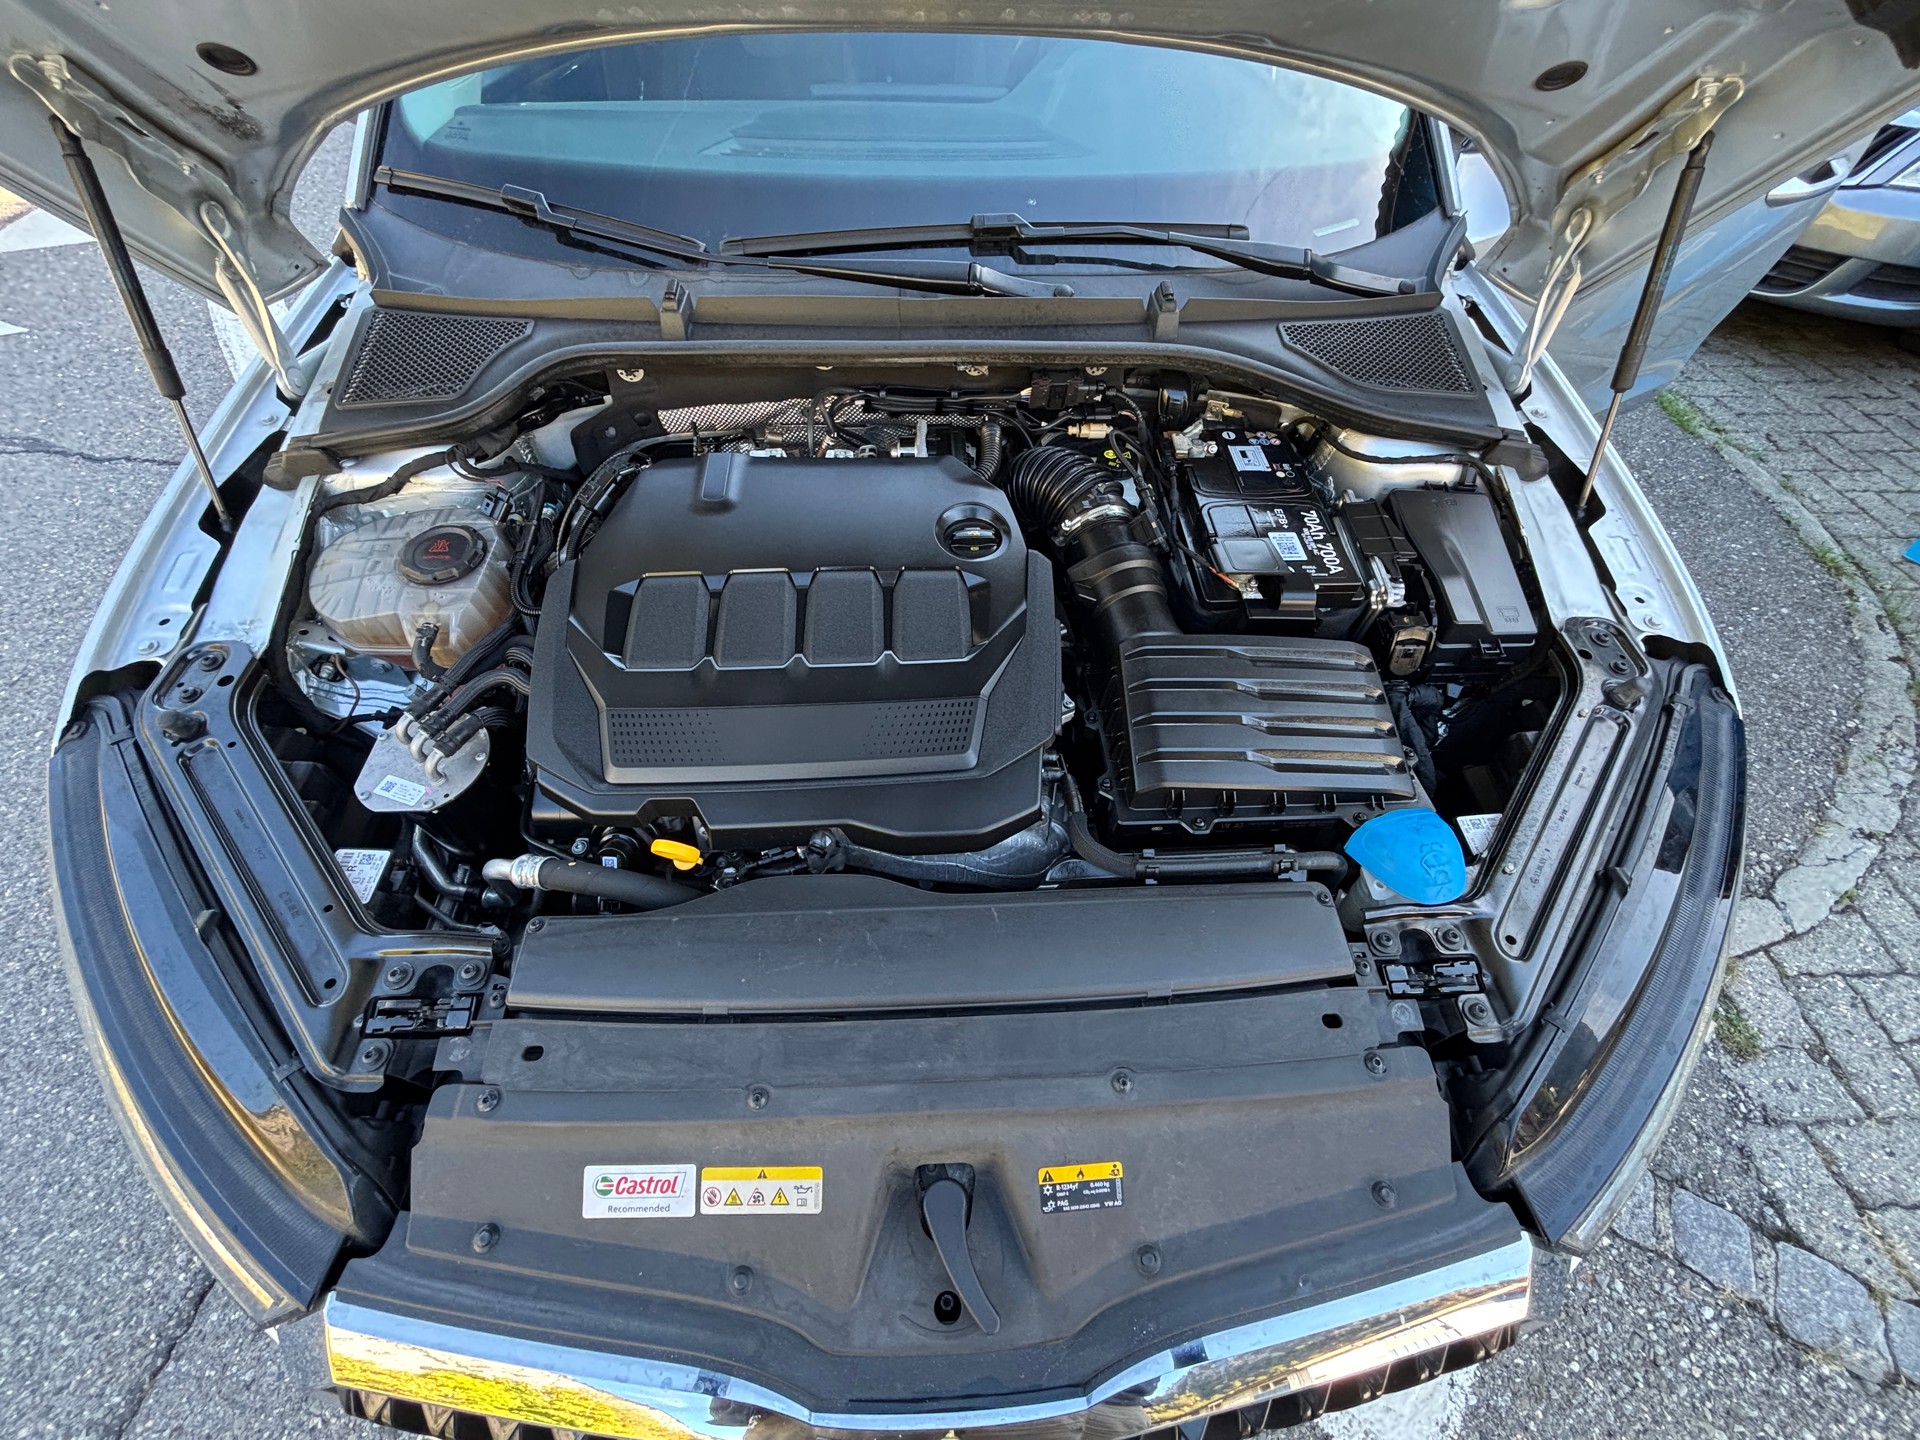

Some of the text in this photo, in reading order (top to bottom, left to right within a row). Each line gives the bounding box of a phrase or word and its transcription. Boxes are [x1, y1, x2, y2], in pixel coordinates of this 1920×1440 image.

[1274, 508, 1289, 529] EFB+
[1300, 510, 1327, 540] 70Ah
[1316, 542, 1344, 575] 700A
[614, 1174, 680, 1196] Castrol
[1056, 1183, 1079, 1191] R-1234yf
[607, 1203, 671, 1214] Recommended
